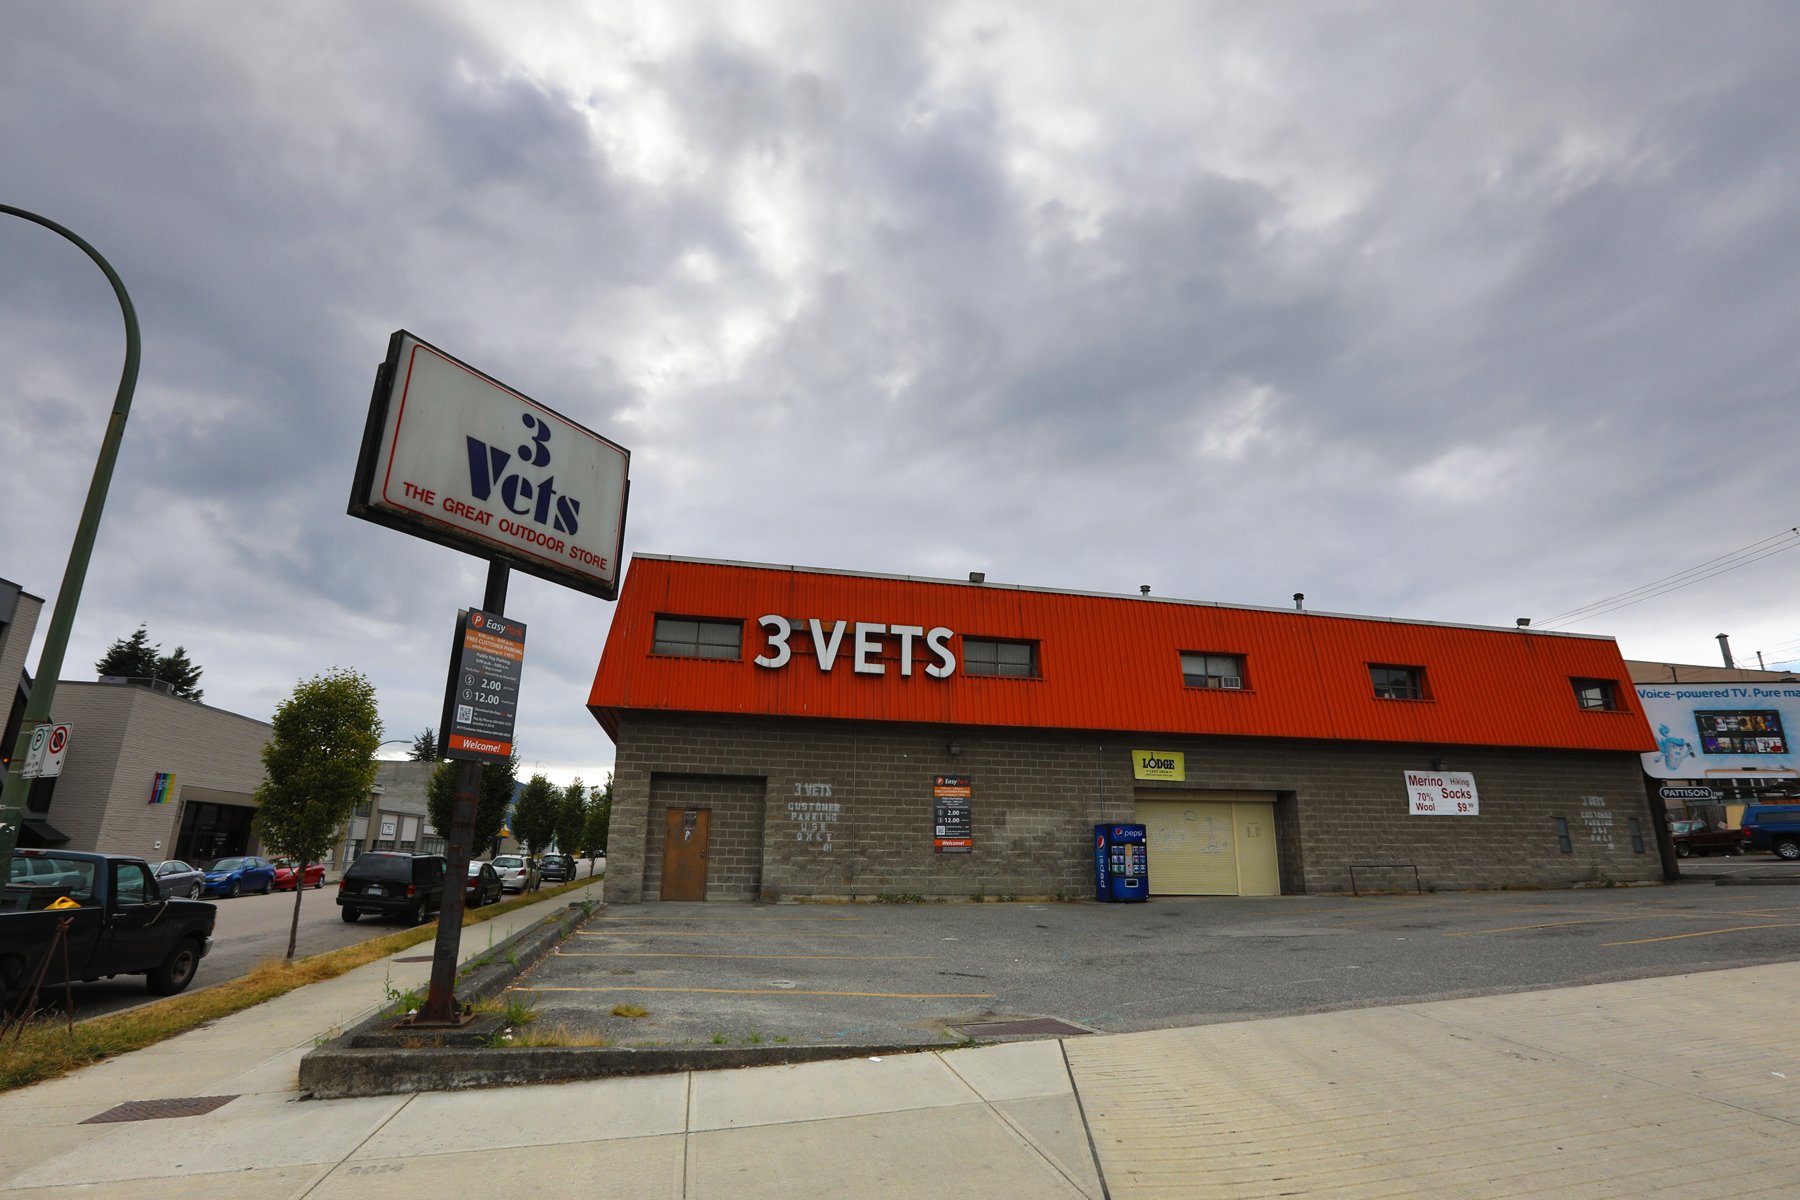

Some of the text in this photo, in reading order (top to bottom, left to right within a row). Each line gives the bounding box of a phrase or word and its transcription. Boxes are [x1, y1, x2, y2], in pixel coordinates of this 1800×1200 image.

[518, 413, 551, 468] 3
[466, 434, 580, 536] Vets
[403, 481, 608, 570] THE GREAT OUTDOOR STORE
[466, 635, 523, 655] FREE CUSTOMER PARKING
[754, 614, 956, 678] 3 VETS
[496, 657, 511, 665] Parking
[481, 679, 501, 691] 2.00
[474, 692, 500, 705] 12.00
[1638, 688, 1729, 700] Voice-powered
[1753, 688, 1786, 698] Pure
[463, 738, 501, 753] Welcome!
[1142, 758, 1175, 769] LODGE
[1408, 775, 1470, 787] Merino Hiking
[794, 783, 832, 796] 3 VETS
[1441, 787, 1472, 799] Socks
[1663, 789, 1709, 797] PATTISON
[1417, 792, 1434, 802] 70%
[788, 802, 840, 812] CUSTOMER
[1416, 802, 1435, 811] Wool
[791, 812, 837, 821] PARKING
[801, 822, 826, 832] USE
[796, 832, 832, 842] ONLY
[1124, 830, 1143, 838] pepsi
